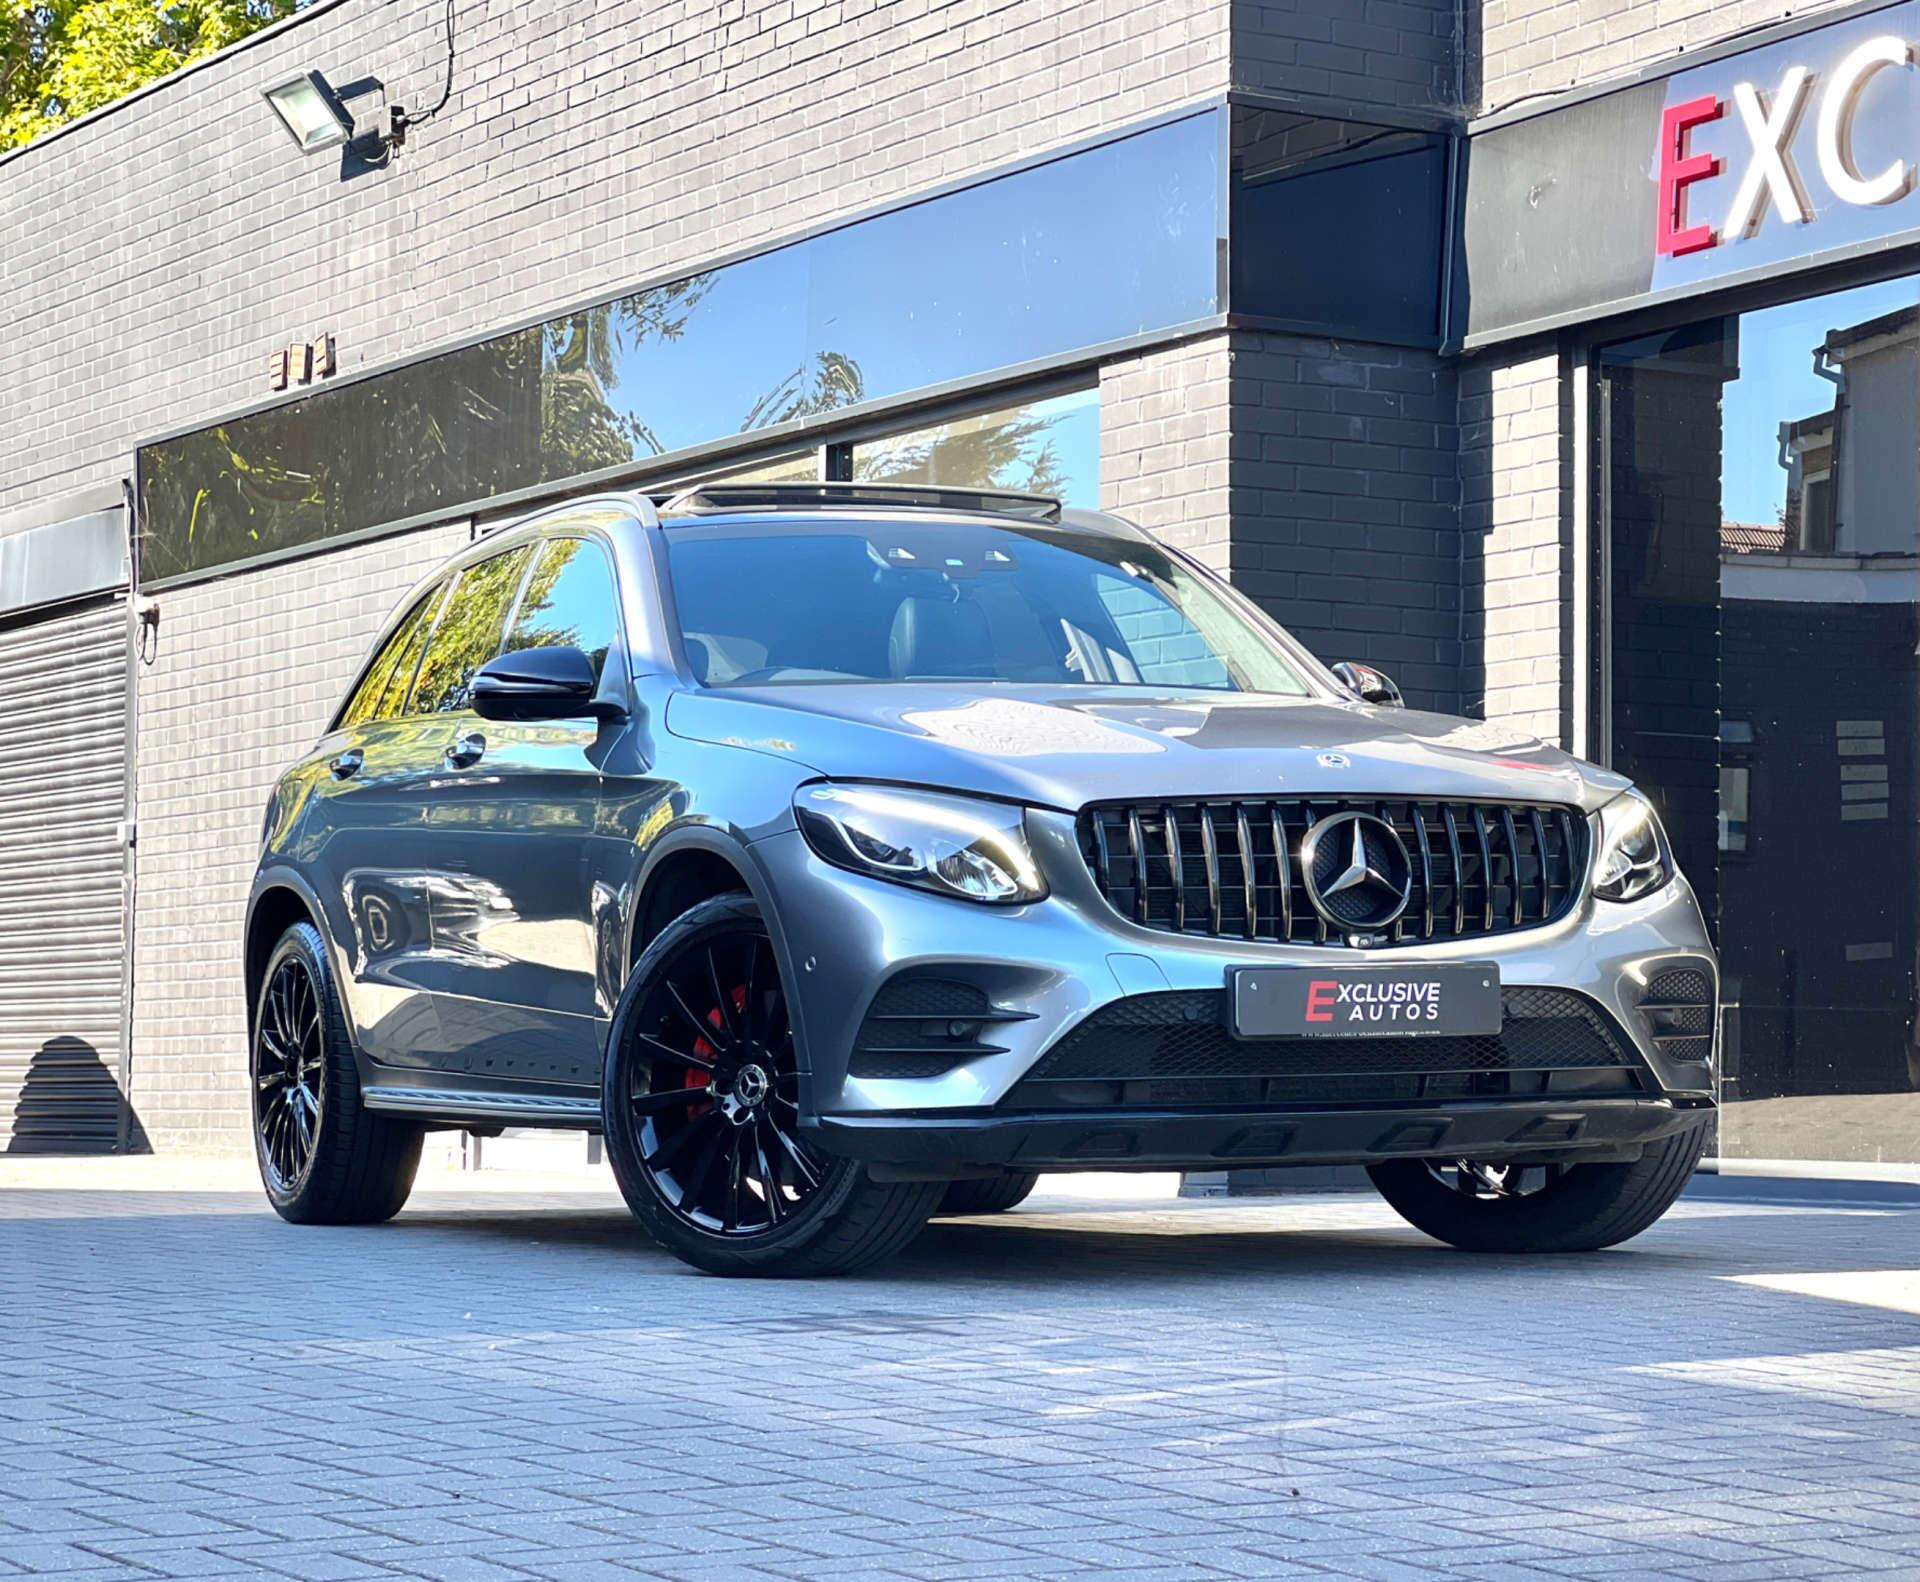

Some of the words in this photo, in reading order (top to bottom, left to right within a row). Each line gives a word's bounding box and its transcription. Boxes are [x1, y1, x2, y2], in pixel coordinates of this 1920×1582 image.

[1656, 36, 1912, 256] EXC
[1305, 980, 1441, 1022] EXCLUSIVE
[1348, 1003, 1439, 1021] AUTOS
